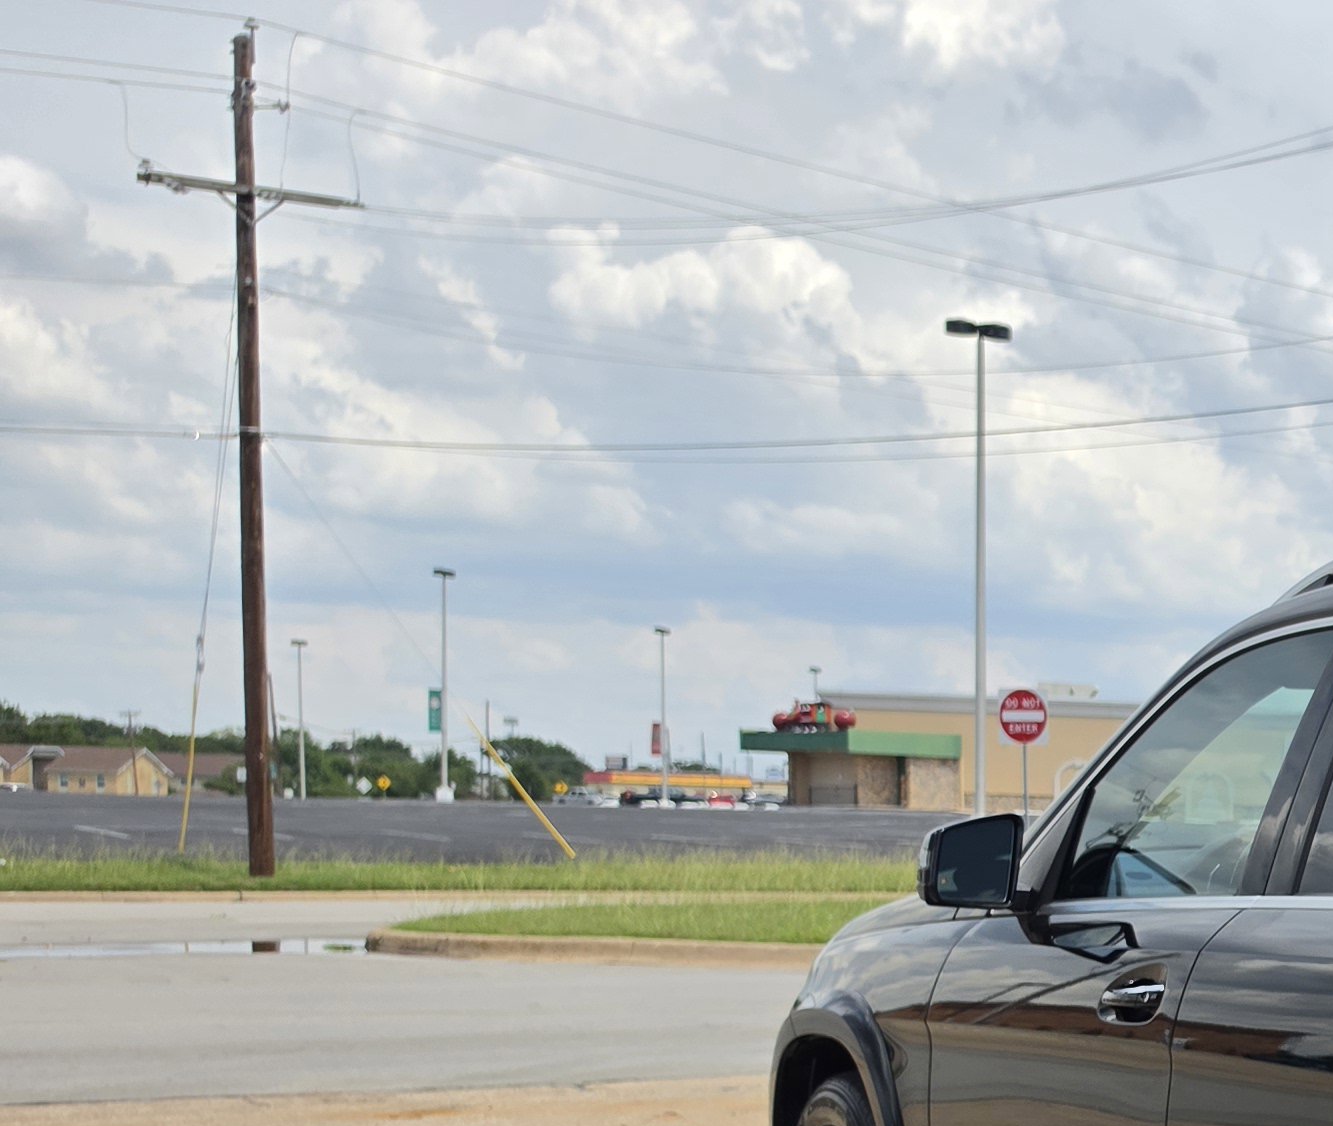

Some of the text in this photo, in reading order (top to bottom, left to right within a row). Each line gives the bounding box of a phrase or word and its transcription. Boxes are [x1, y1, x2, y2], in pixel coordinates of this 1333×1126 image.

[1005, 697, 1040, 709] DO NOT
[1008, 723, 1038, 734] ENTER
